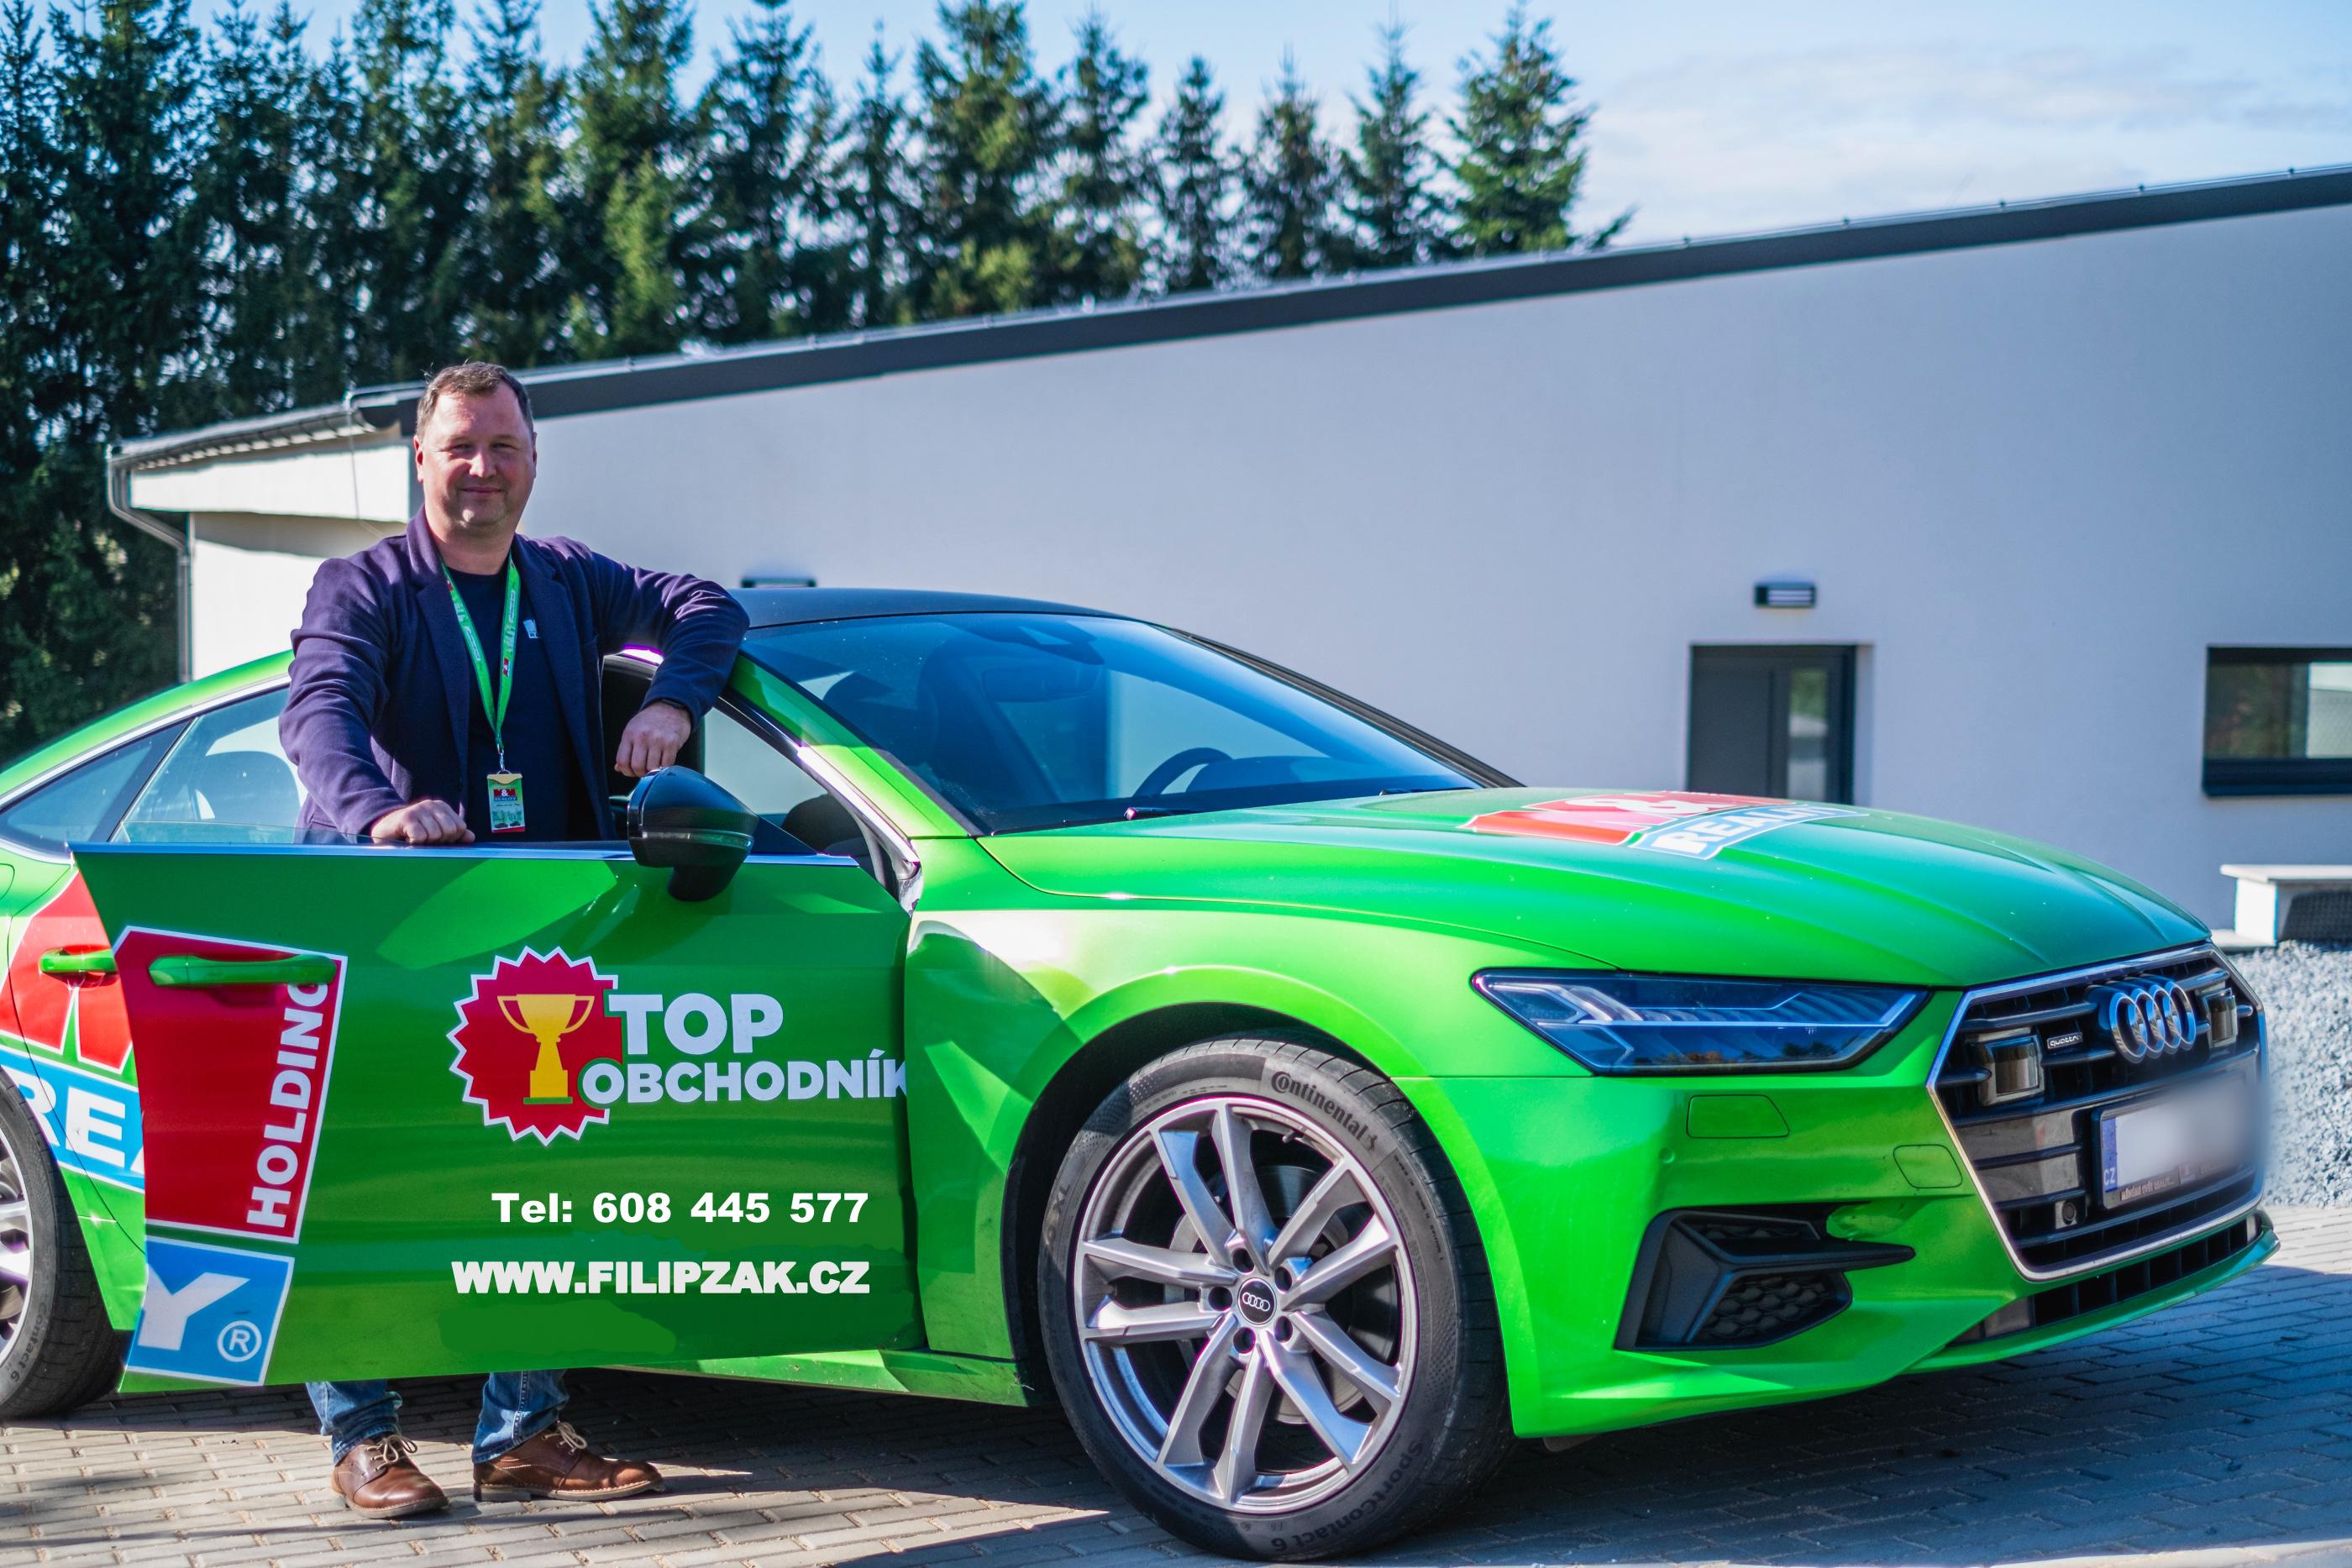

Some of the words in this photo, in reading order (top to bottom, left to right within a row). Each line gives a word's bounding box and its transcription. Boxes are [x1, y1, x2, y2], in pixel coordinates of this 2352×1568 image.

[608, 992, 784, 1056] TOP
[1271, 1071, 1369, 1141] Continental
[2103, 1167, 2116, 1186] CZ
[491, 1193, 573, 1224] Tel:
[592, 1193, 671, 1224] 608
[690, 1193, 770, 1224] 445
[790, 1193, 869, 1224] 577
[451, 1261, 870, 1294] WWW.FILIPZAK.CZ
